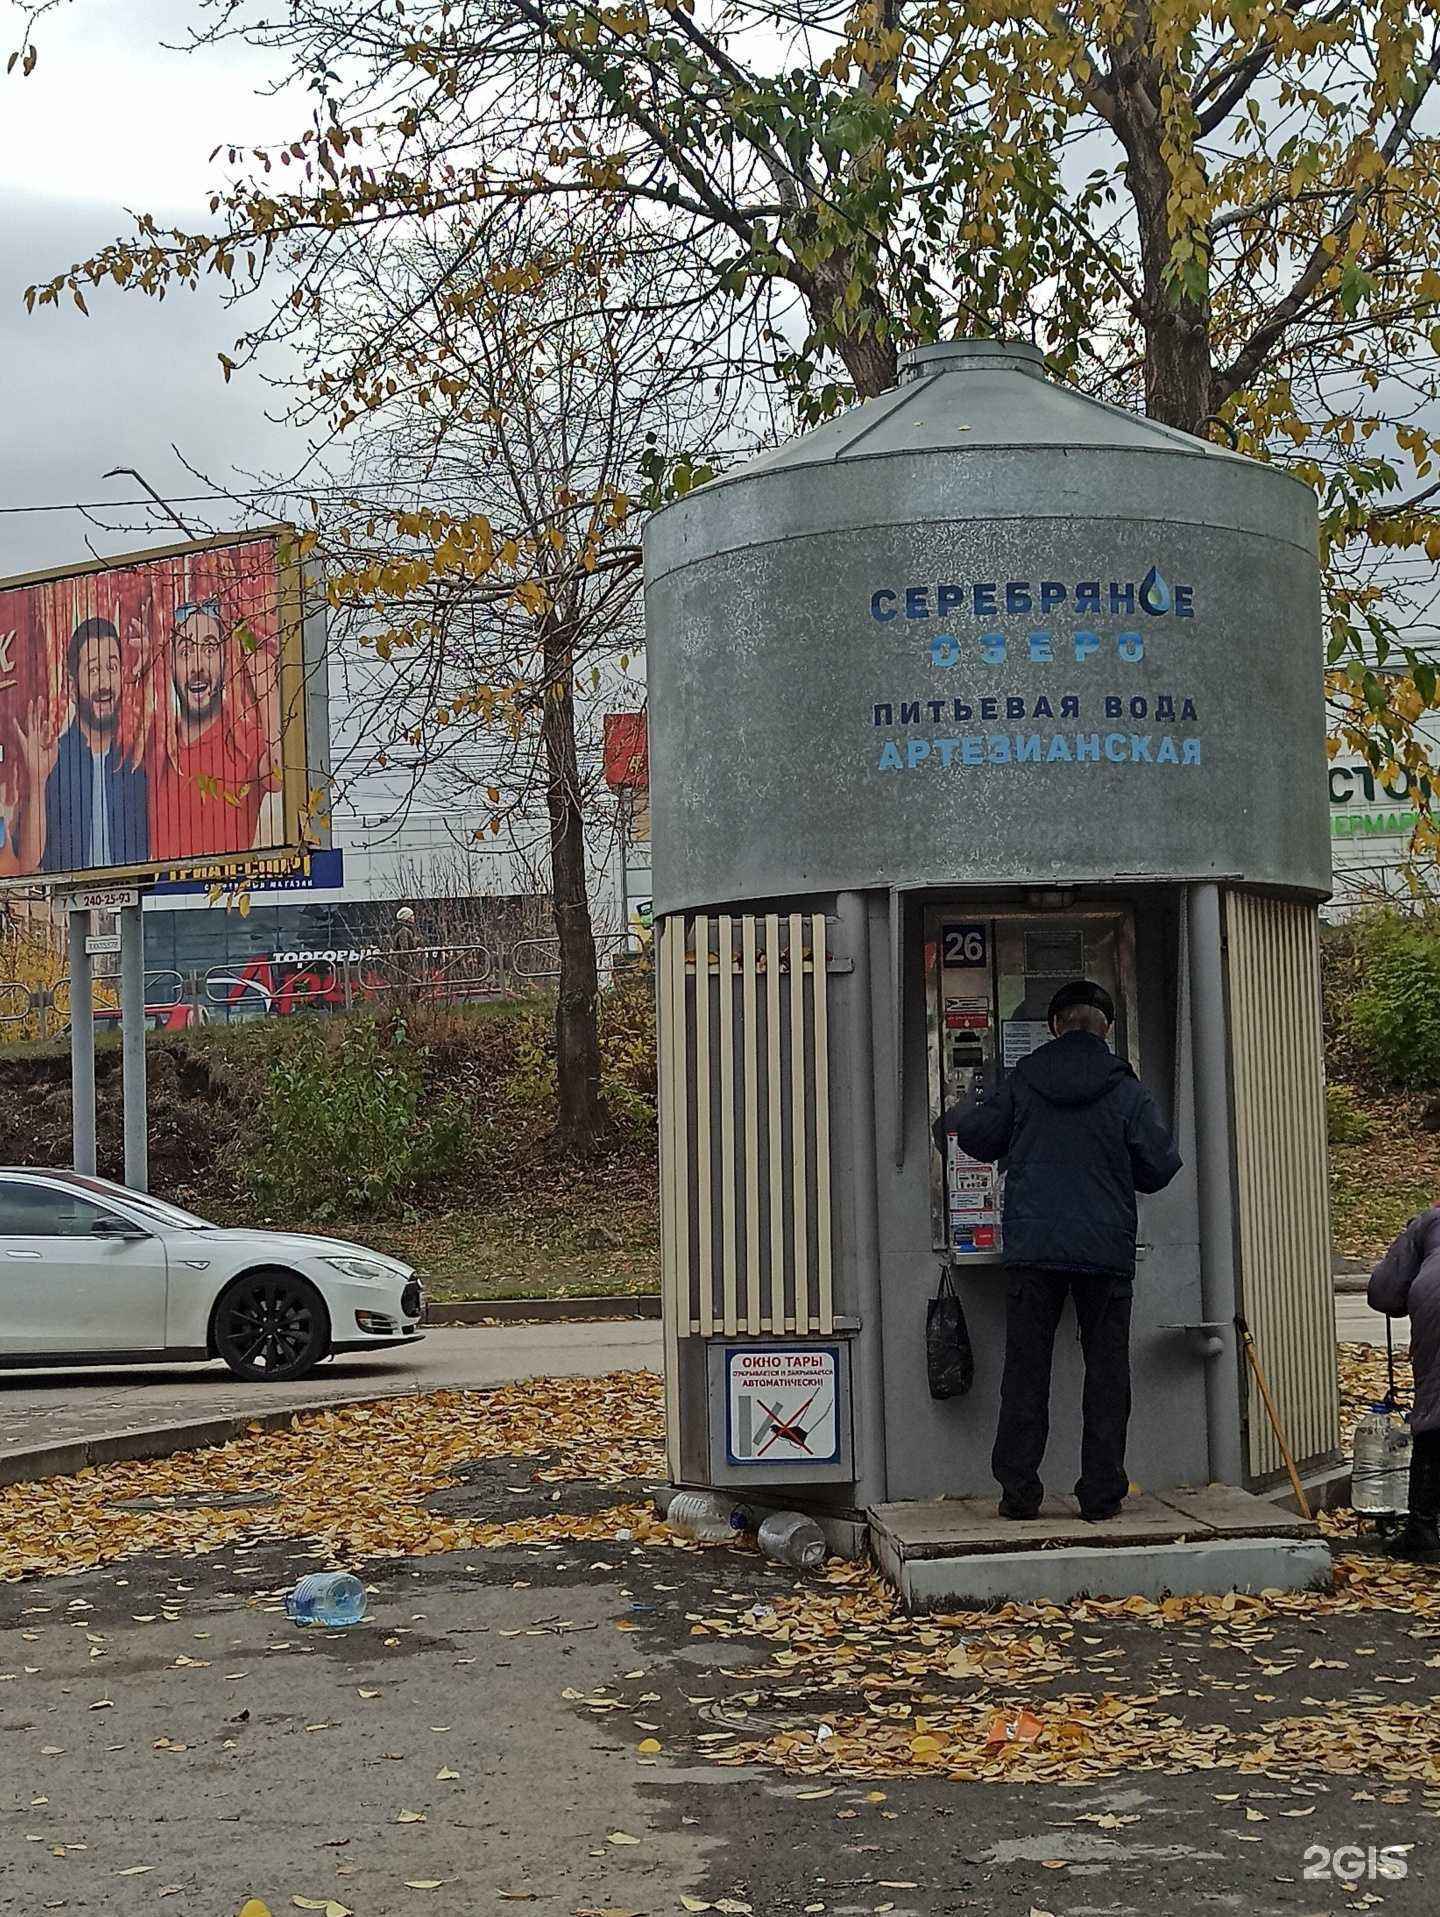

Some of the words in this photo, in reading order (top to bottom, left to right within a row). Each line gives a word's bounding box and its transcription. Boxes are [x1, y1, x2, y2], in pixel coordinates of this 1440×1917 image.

[871, 565, 1195, 622] СЕРЕБРЯНОЕ
[930, 631, 1145, 668] ОЗЕРО
[873, 696, 1080, 726] ПИТЬЕВАЯ
[1105, 696, 1198, 722] ВОДА
[878, 733, 1201, 771] АРТЕЗИАНСКАЯ
[83, 893, 131, 907] 240-25-93
[945, 932, 984, 962] 26
[742, 1356, 781, 1368] ОКНО
[785, 1356, 823, 1367] ТАРЫ
